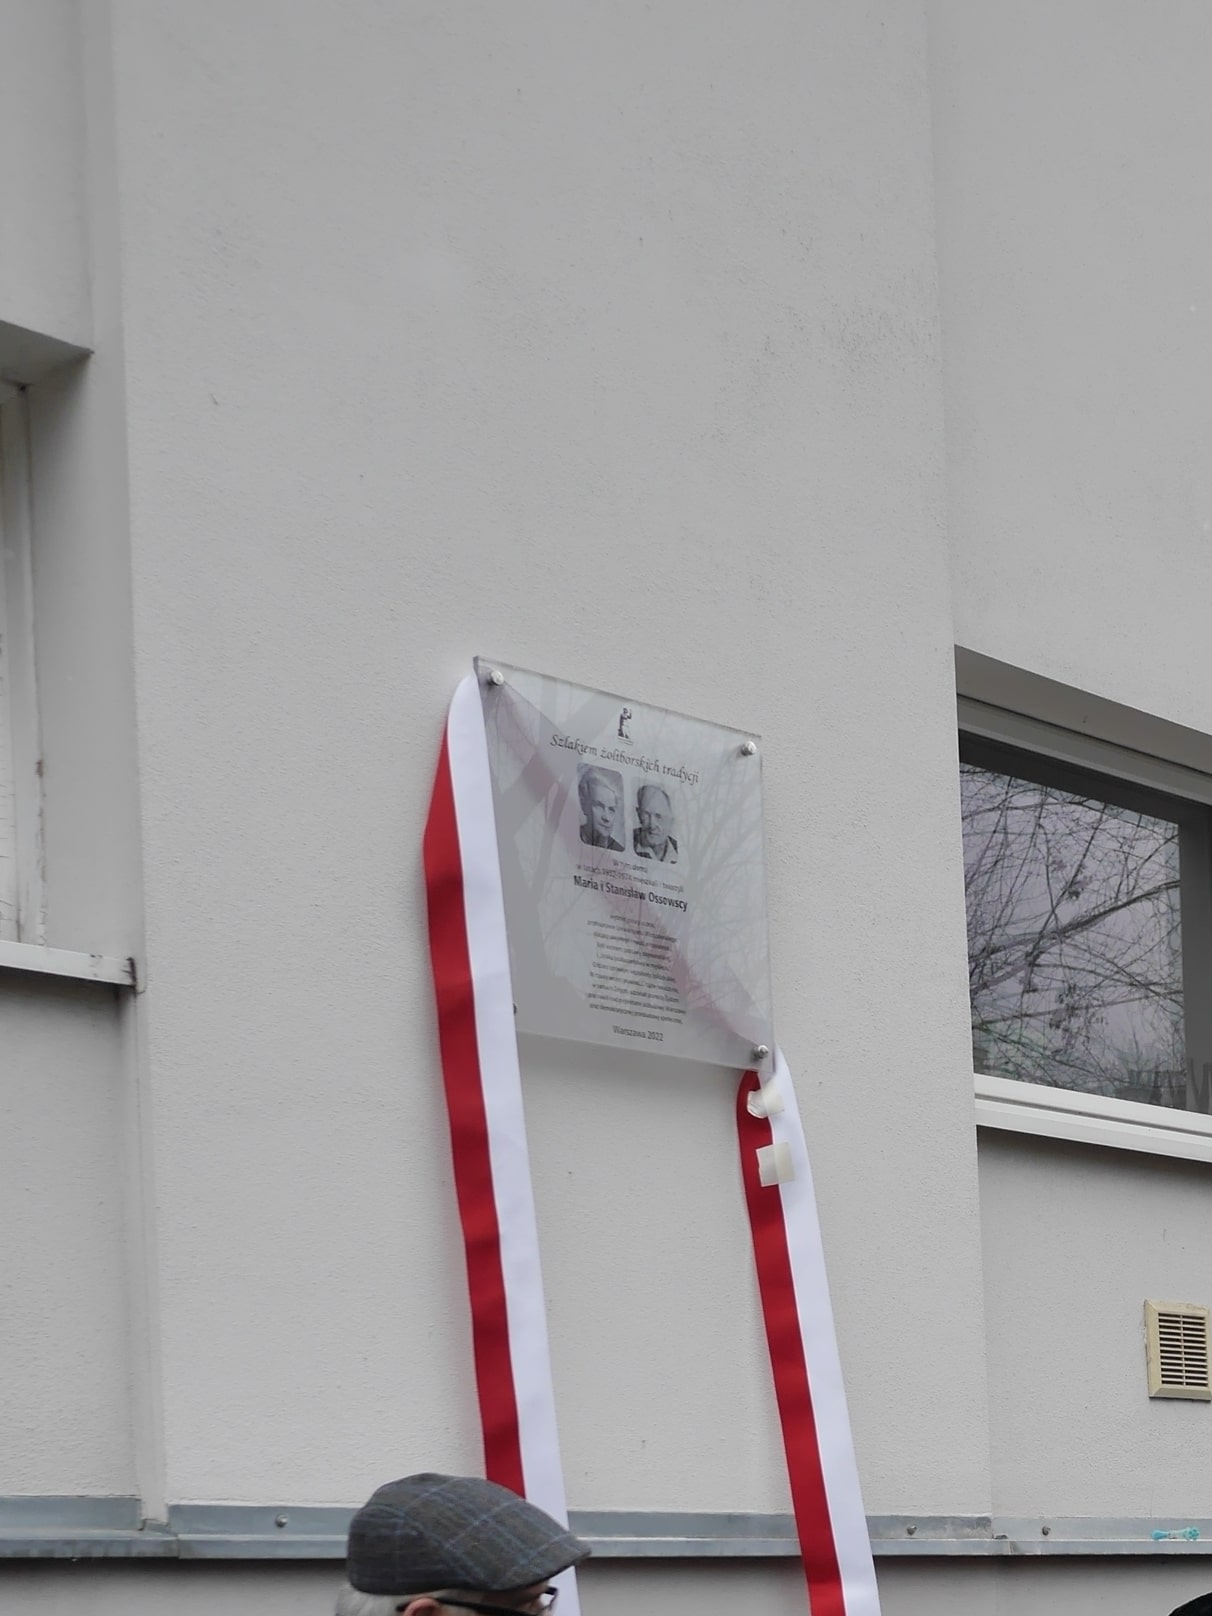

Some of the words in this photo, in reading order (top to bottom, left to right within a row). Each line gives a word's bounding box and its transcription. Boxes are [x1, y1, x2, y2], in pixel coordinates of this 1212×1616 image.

[550, 734, 597, 756] Szlakiem
[600, 747, 660, 773] żoliborskich
[662, 764, 699, 786] tradycji
[573, 875, 598, 890] Maria
[599, 880, 604, 892] i
[605, 881, 646, 900] Stanisław
[648, 891, 688, 912] Ossowscy
[613, 1025, 646, 1038] Warszawa
